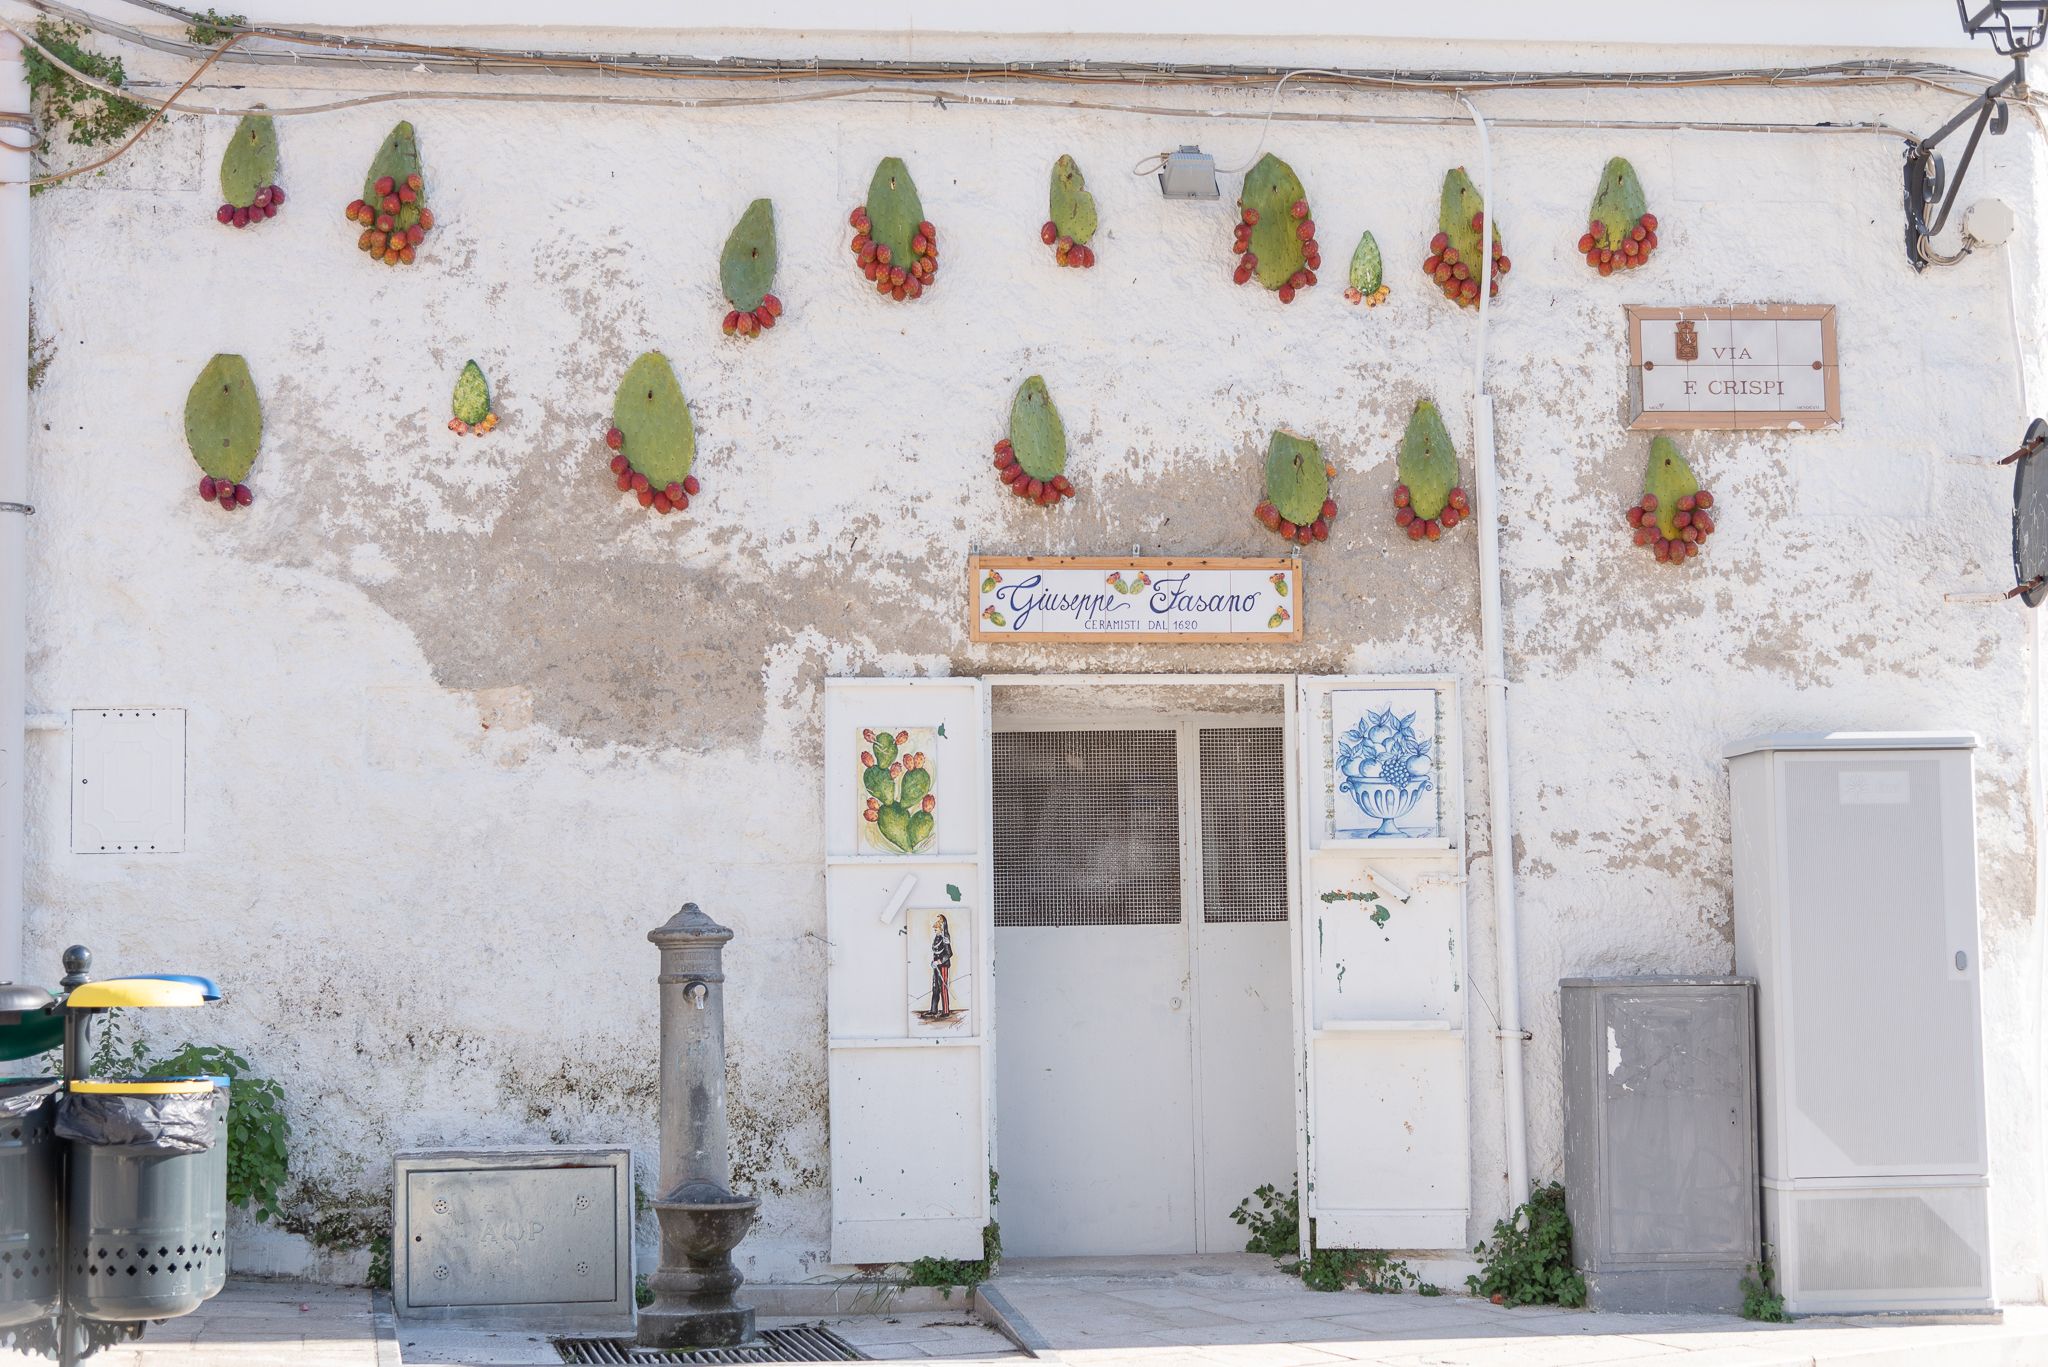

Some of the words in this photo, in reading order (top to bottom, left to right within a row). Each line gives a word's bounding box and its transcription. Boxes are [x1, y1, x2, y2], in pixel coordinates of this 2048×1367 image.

[1712, 347, 1752, 360] VIA
[1683, 380, 1697, 395] F.
[1707, 380, 1785, 395] CRISPI
[996, 574, 1131, 631] Giuseppe
[1149, 573, 1262, 614] Fasano
[1084, 619, 1140, 630] CERAMISTI
[1148, 619, 1168, 630] DAL
[1173, 620, 1198, 630] 1620
[480, 1221, 545, 1251] AQP
